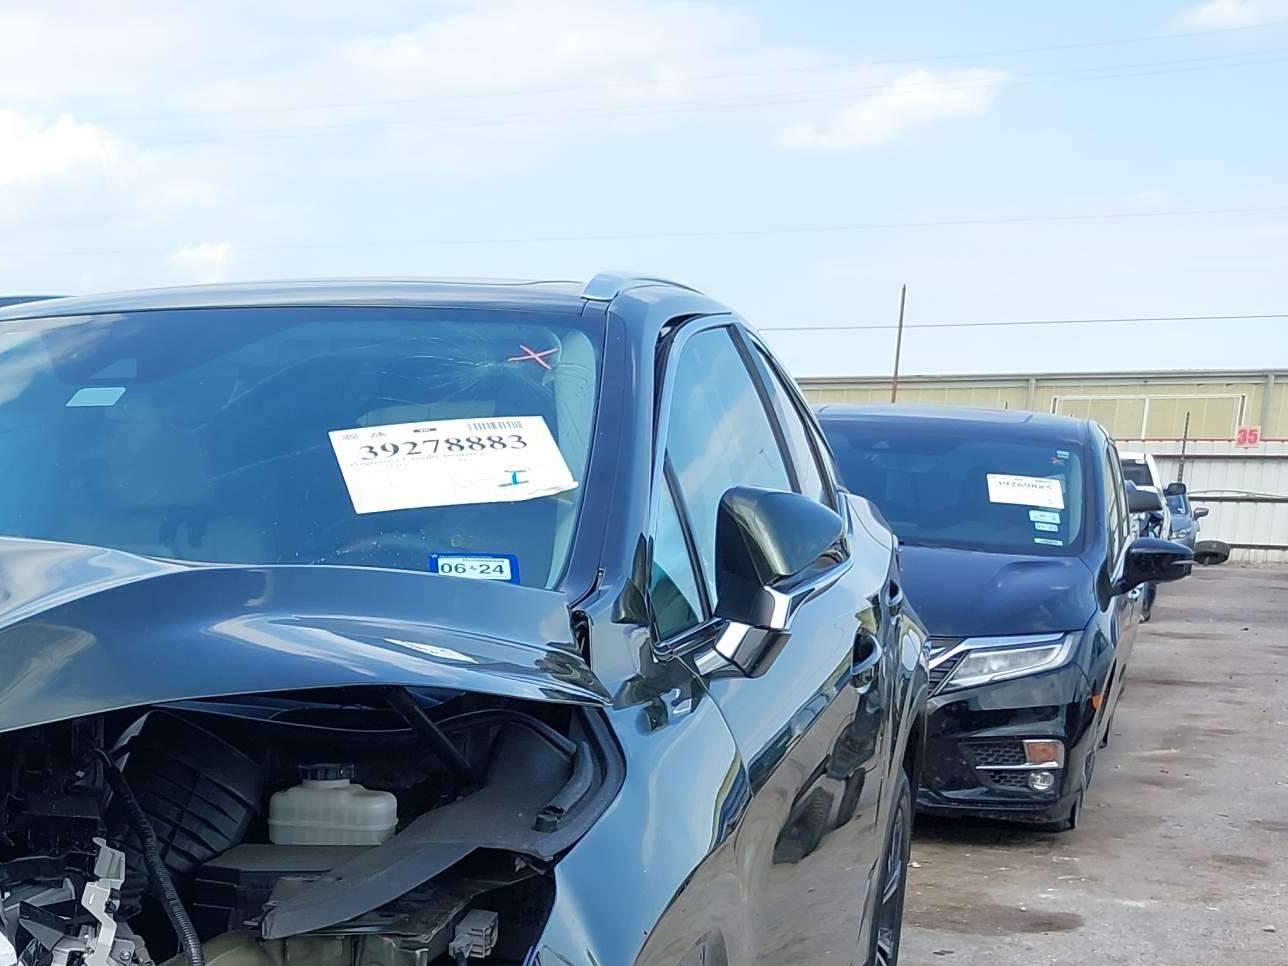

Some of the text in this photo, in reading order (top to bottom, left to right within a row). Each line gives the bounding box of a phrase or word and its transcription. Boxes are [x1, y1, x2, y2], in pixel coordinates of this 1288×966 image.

[1238, 429, 1258, 445] 35
[360, 434, 528, 461] 39278883
[440, 562, 505, 575] 06 24
